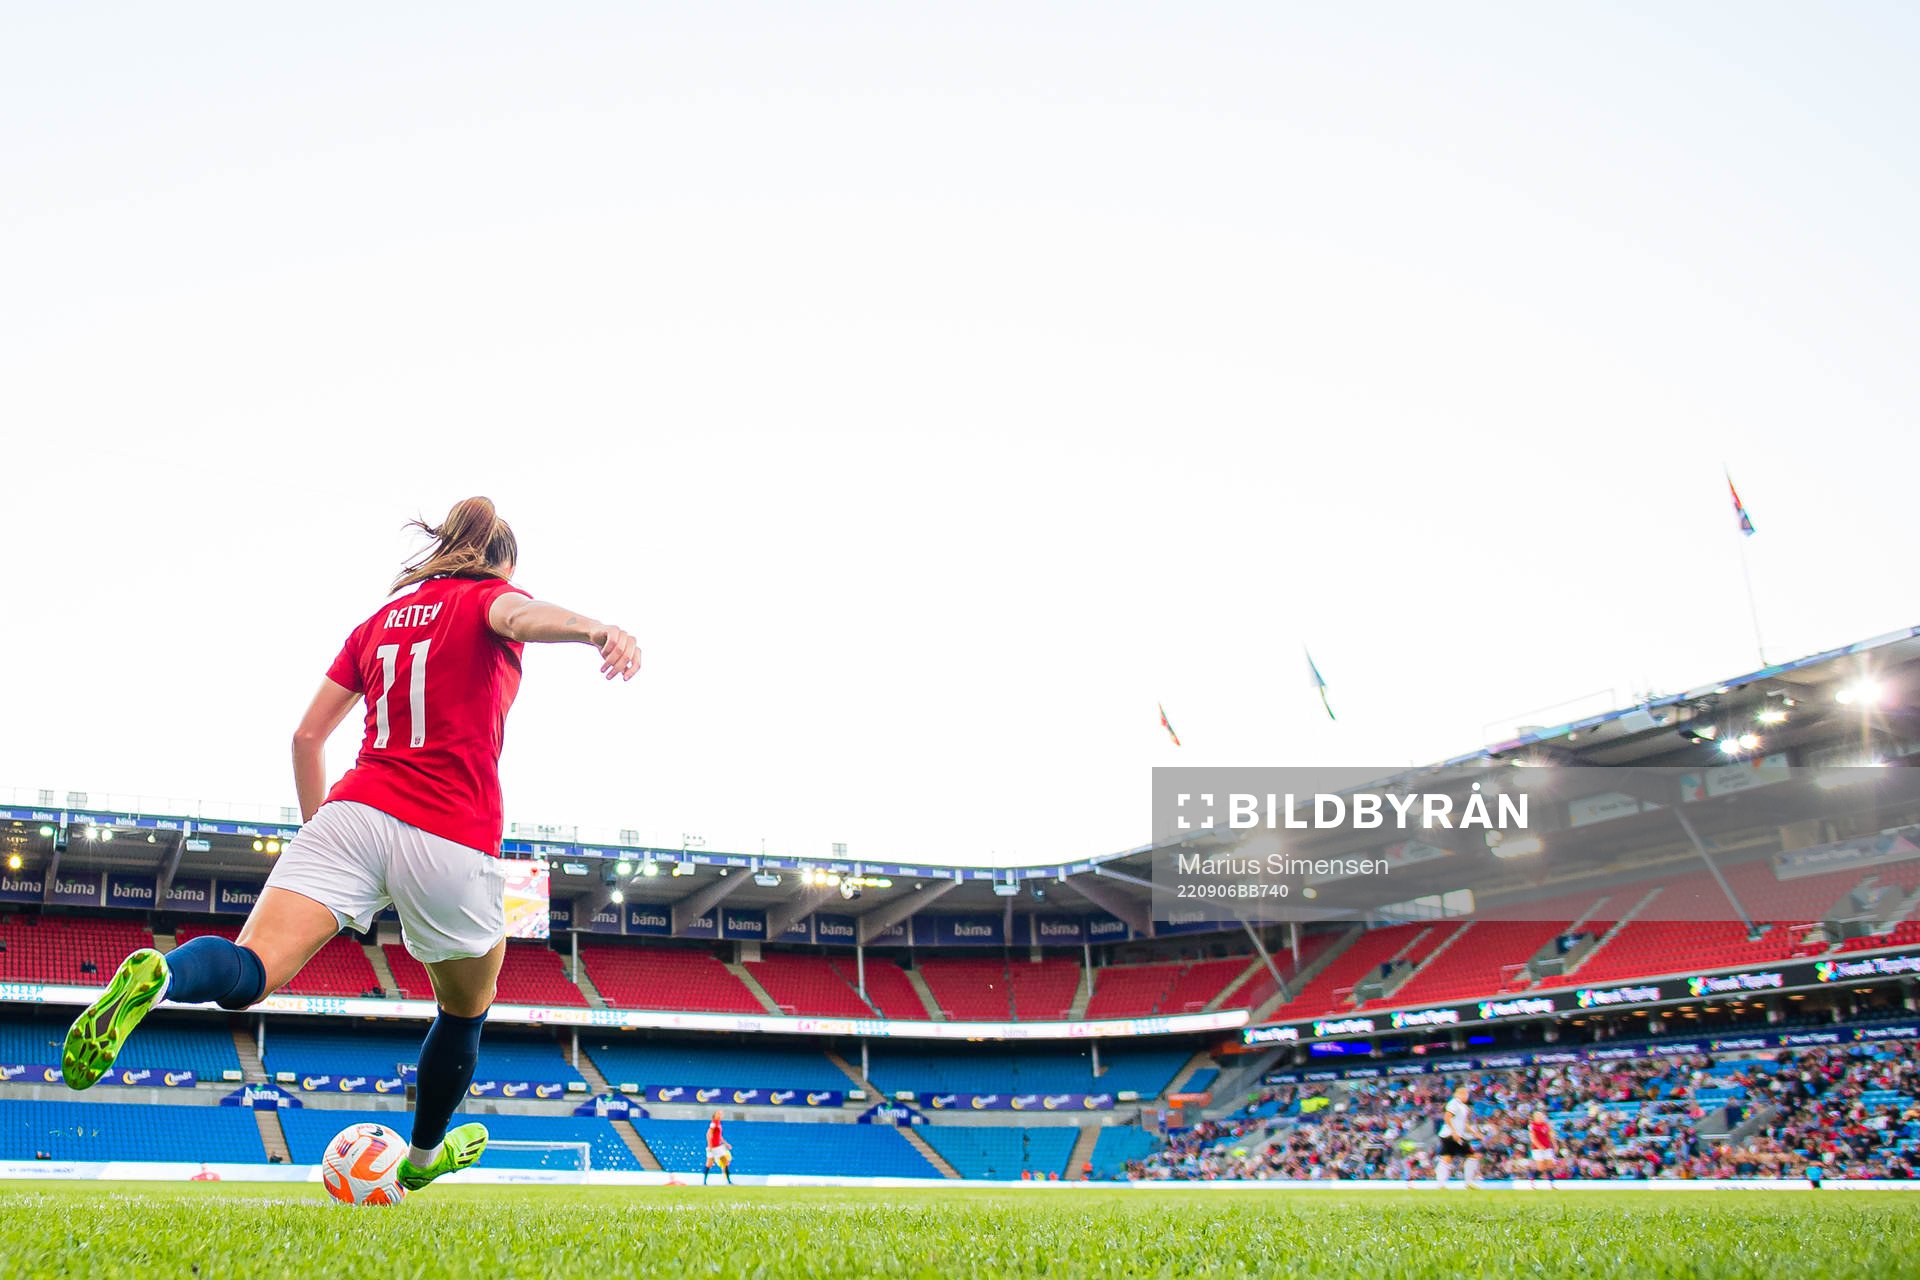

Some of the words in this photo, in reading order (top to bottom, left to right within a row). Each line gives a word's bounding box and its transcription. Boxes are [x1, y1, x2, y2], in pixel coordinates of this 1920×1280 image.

[373, 638, 432, 749] 11
[54, 879, 95, 895] bama
[113, 883, 153, 899] bama
[632, 912, 666, 927] bama
[728, 917, 762, 931] bama
[820, 922, 853, 936] bama
[954, 922, 992, 936] bama
